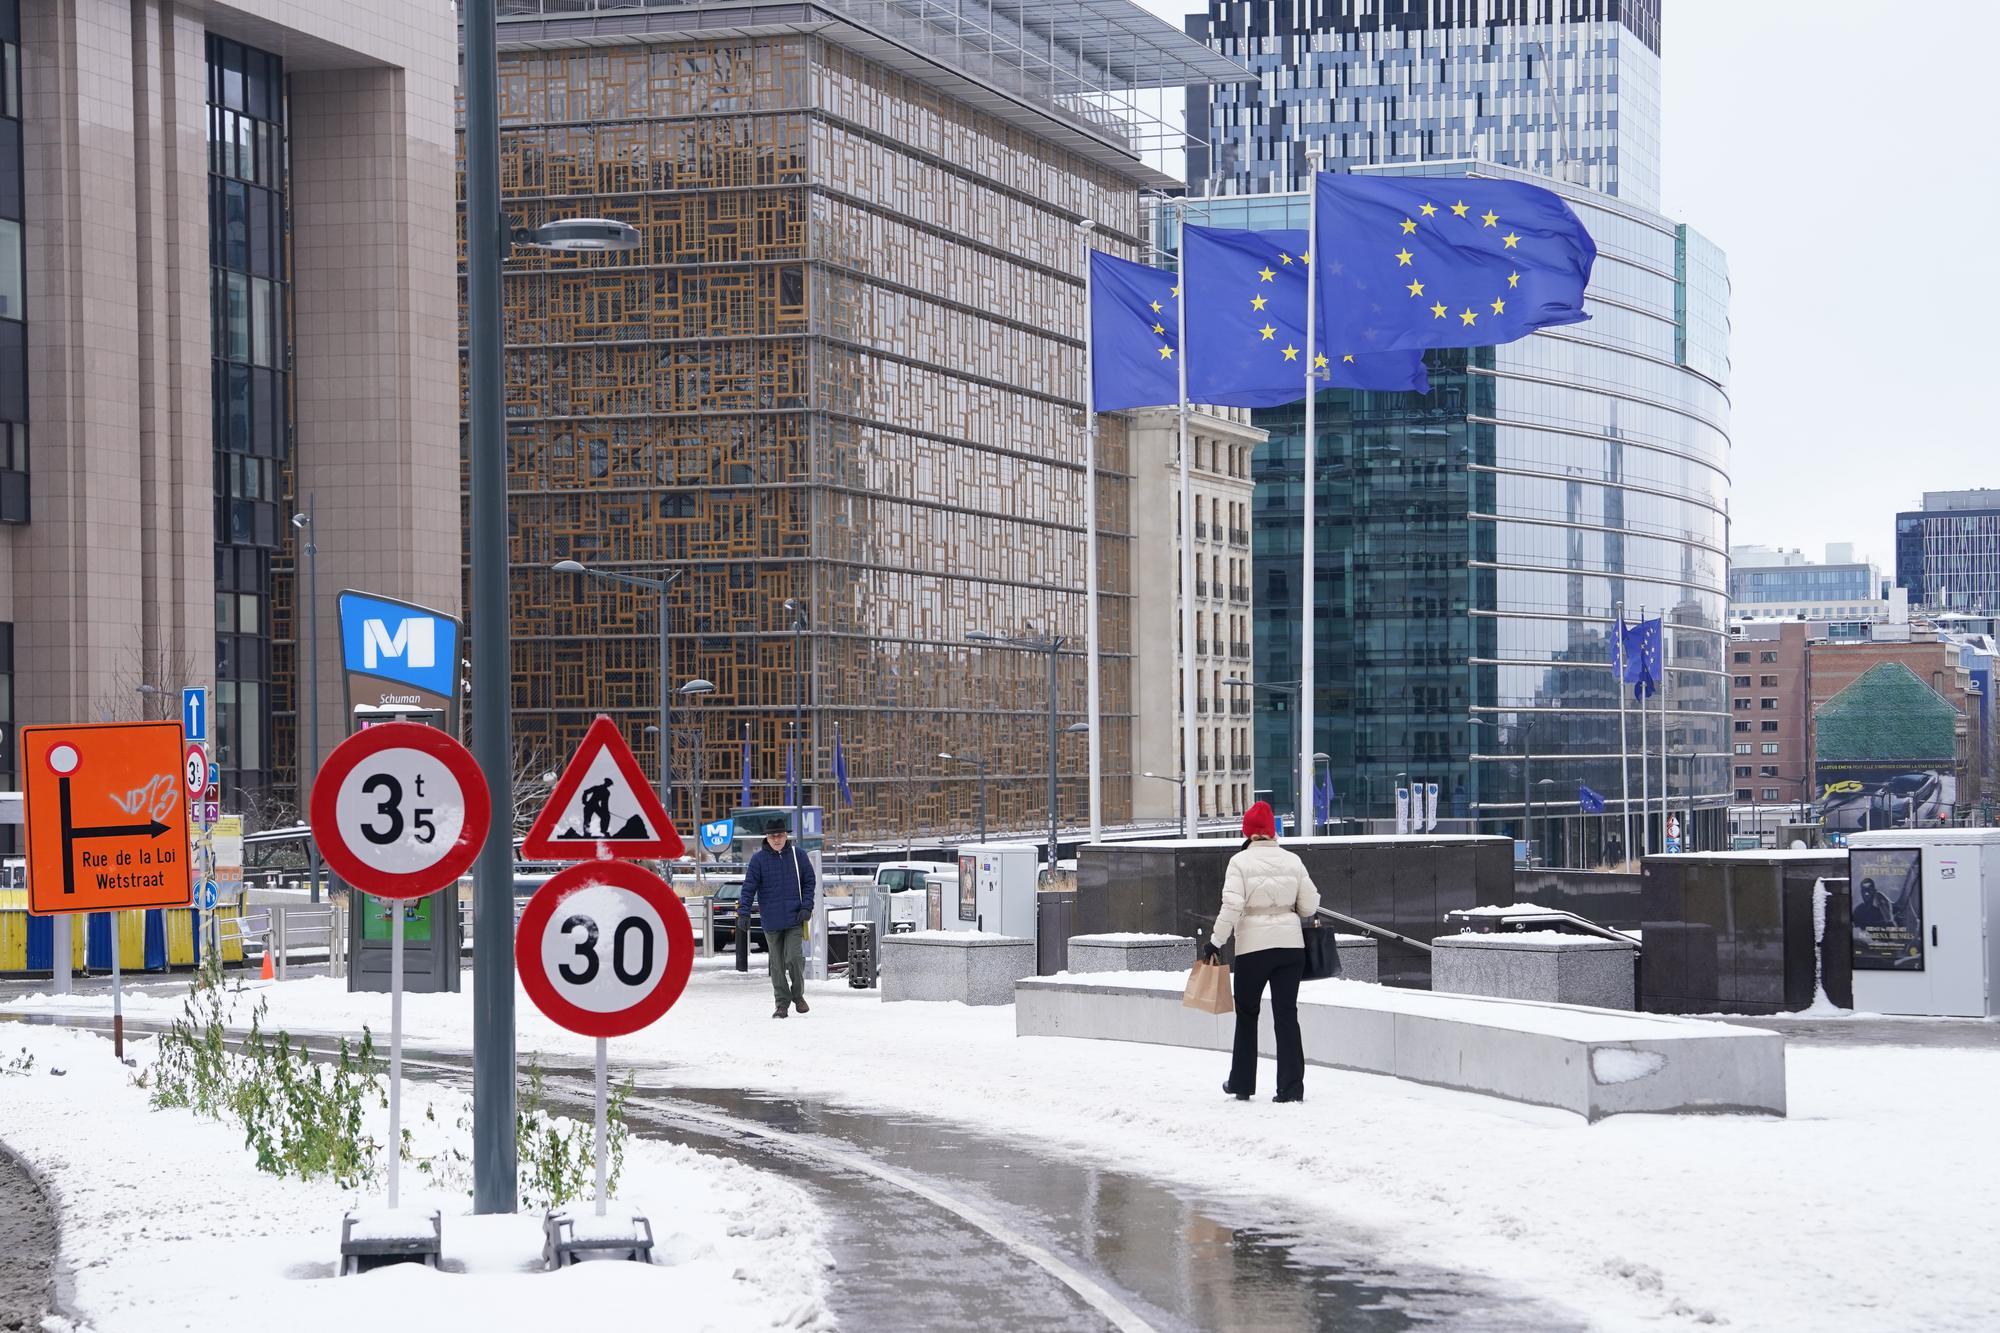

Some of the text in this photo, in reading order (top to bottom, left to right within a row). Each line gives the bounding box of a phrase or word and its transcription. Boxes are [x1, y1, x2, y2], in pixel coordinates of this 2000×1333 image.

[363, 617, 435, 669] M
[380, 693, 421, 704] Schuman
[188, 761, 196, 785] 3
[360, 773, 436, 845] 3 t 5
[706, 824, 728, 837] M
[82, 851, 108, 867] Rue
[116, 850, 132, 866] de
[139, 848, 151, 865] la
[157, 847, 176, 863] Loi
[96, 871, 165, 889] Wetstraat
[558, 914, 654, 987] 30
